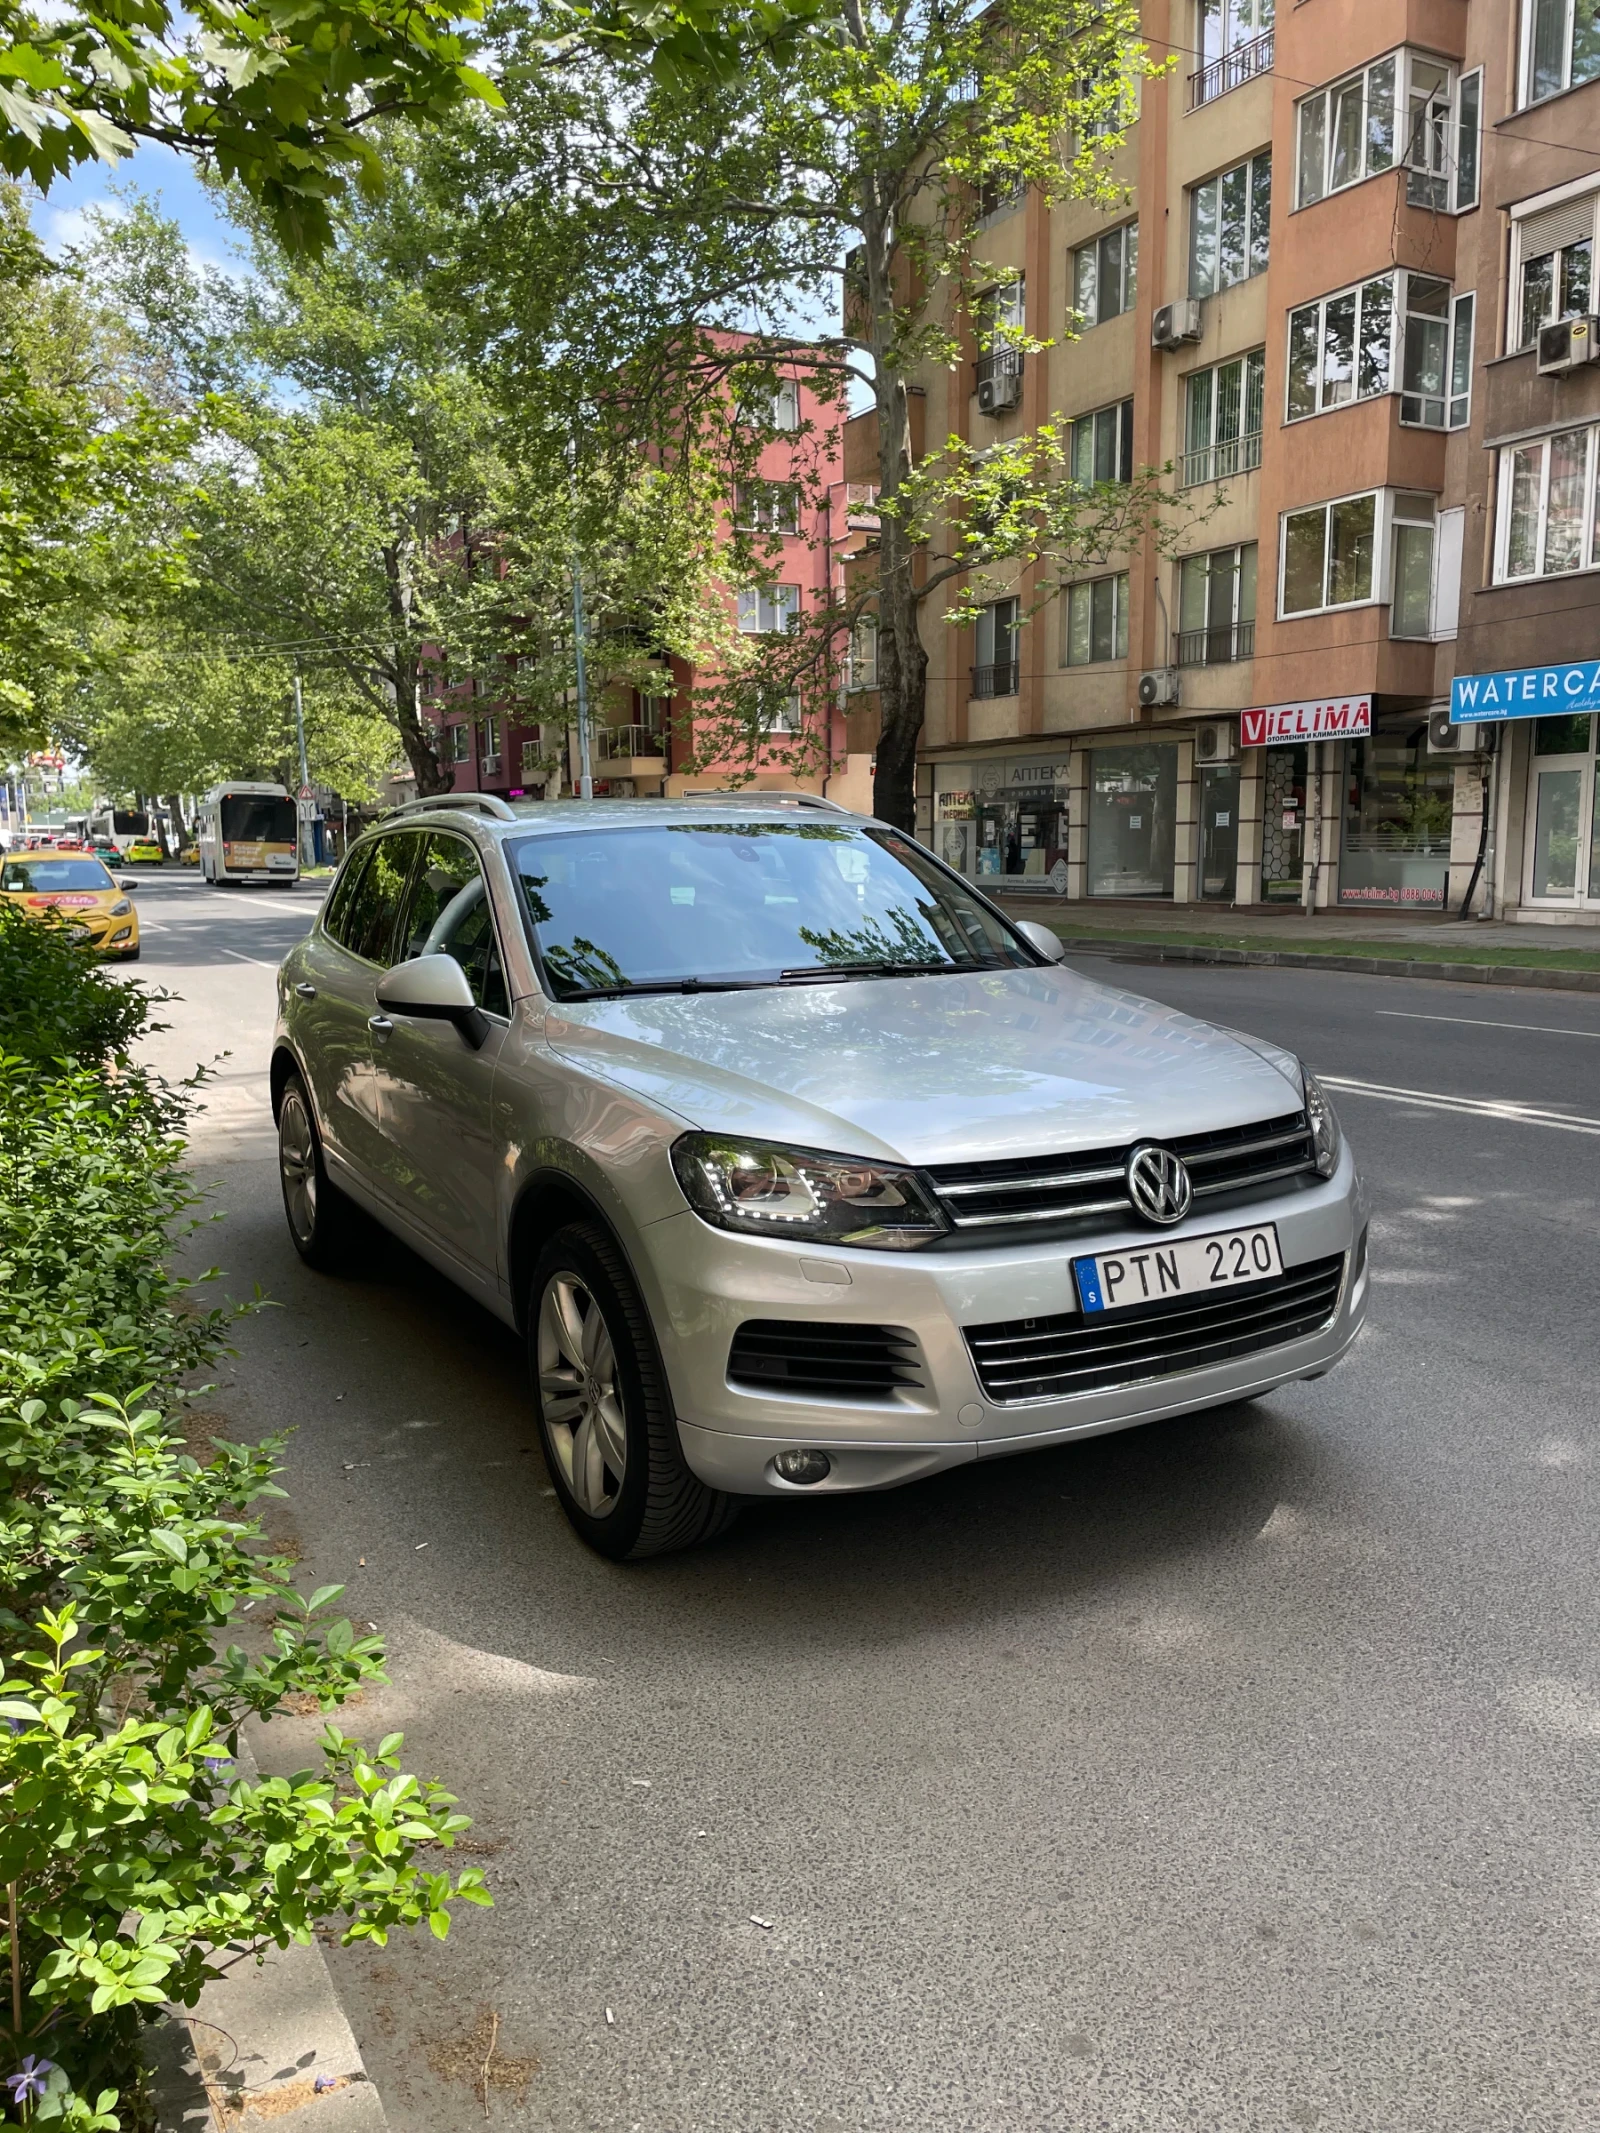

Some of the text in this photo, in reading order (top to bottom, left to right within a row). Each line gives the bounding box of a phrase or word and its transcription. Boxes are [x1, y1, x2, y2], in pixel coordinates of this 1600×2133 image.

[1267, 732, 1306, 743] ОТОПЛЕНИЕ
[1306, 731, 1312, 739] И
[1312, 727, 1370, 739] КЛИМАТИЗАЦИЯ
[1011, 764, 1070, 782] АПТЕКА
[1011, 787, 1070, 797] PHARMACY
[1401, 887, 1420, 901] 0888
[1421, 888, 1436, 901] 004
[1103, 1233, 1271, 1303] PTN 220
[1088, 1291, 1097, 1303] S
